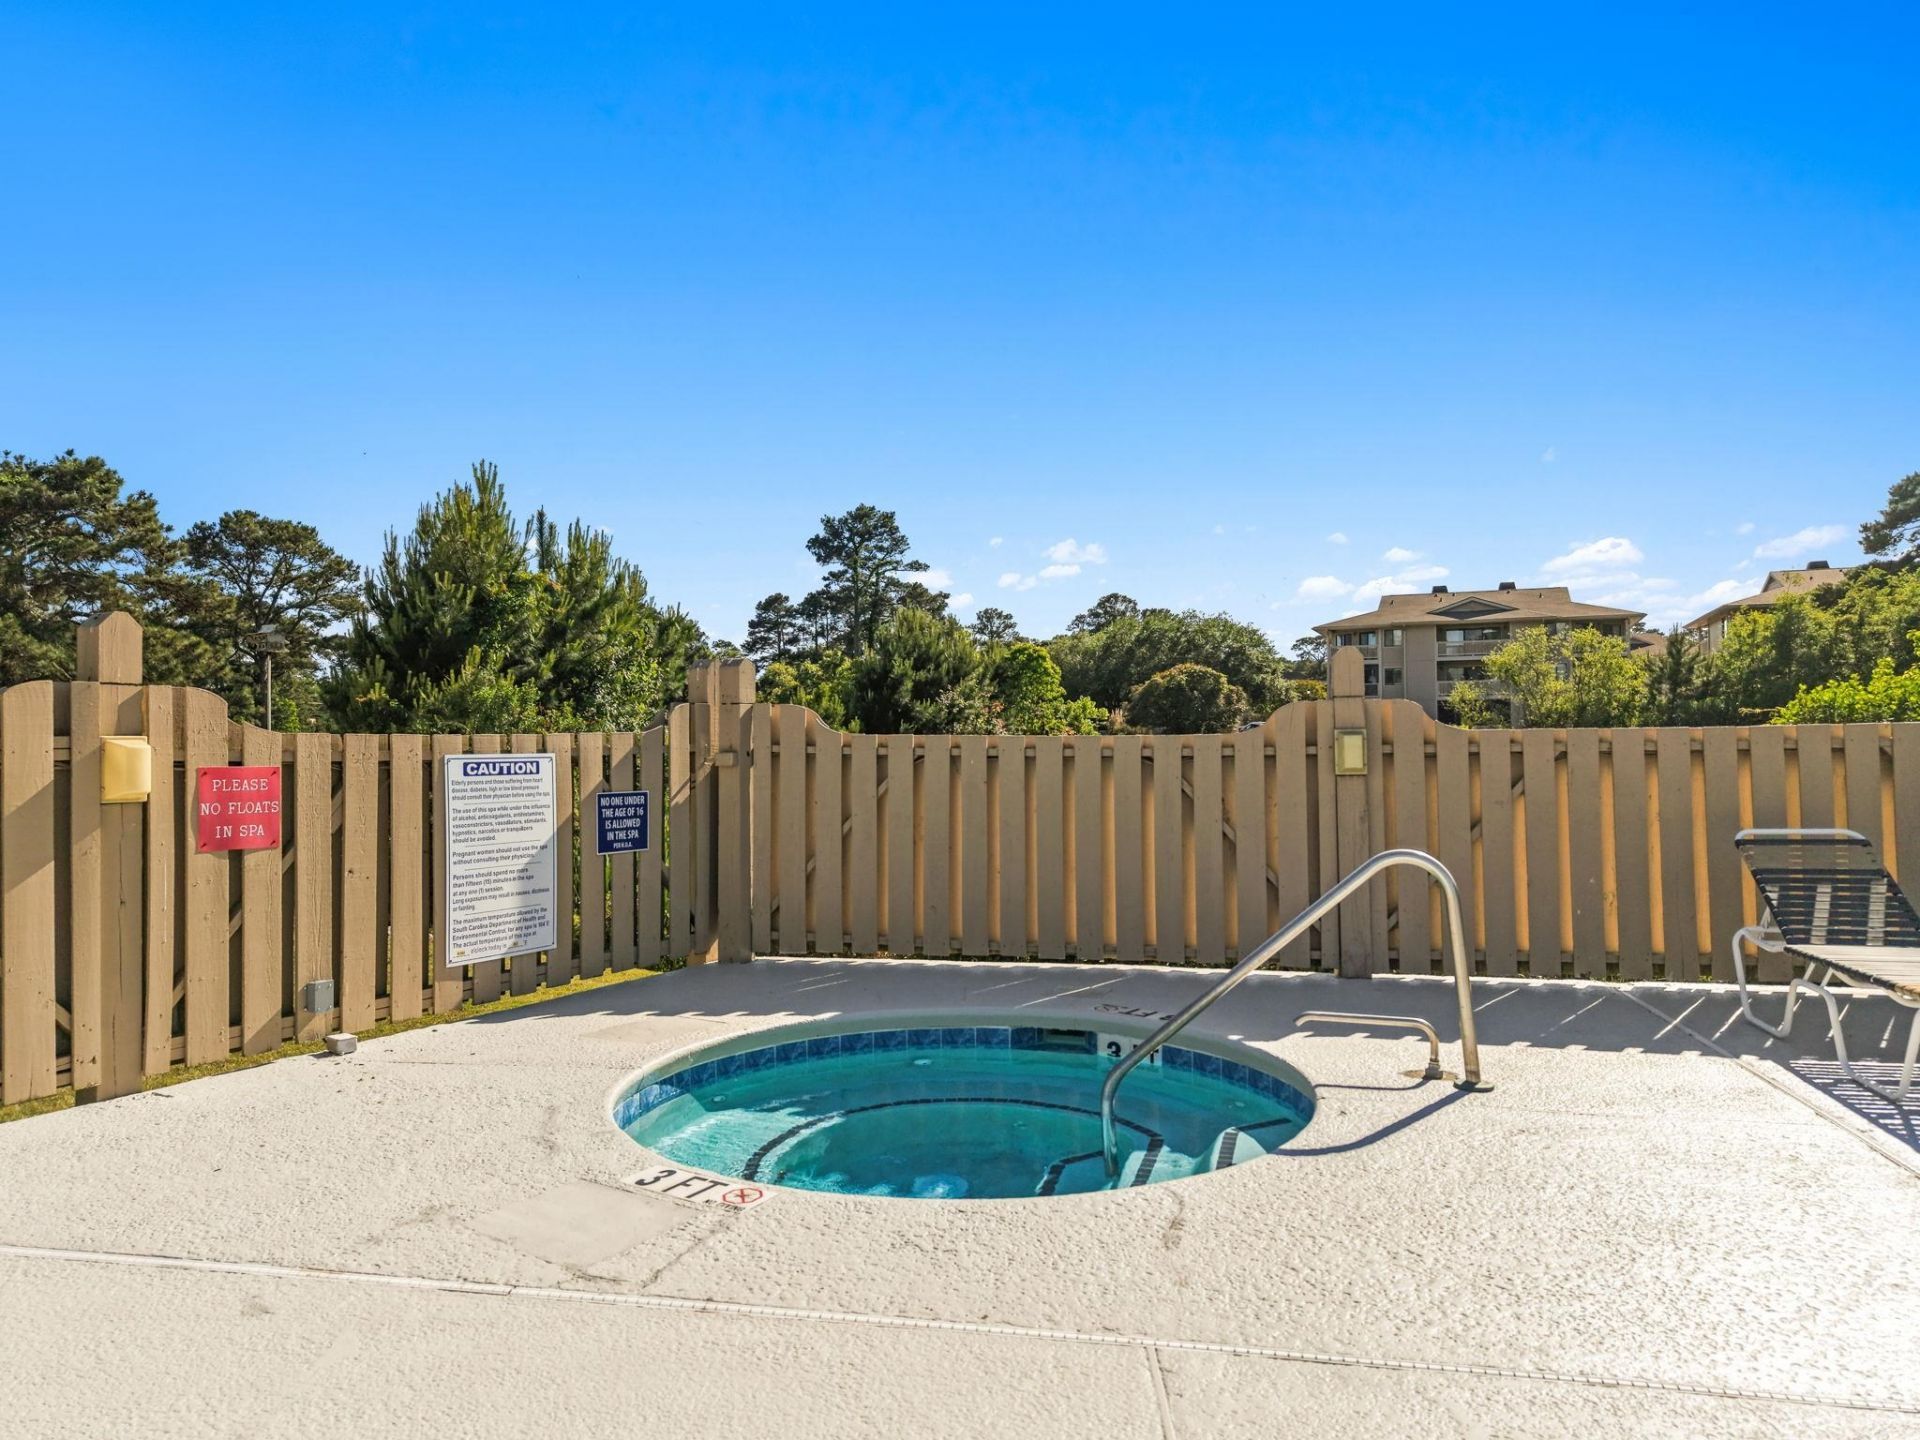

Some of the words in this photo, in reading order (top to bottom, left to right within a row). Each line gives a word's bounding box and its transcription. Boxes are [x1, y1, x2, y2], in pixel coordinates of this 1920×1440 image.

[466, 762, 537, 775] CAUTION
[212, 779, 268, 791] PLEASE
[493, 792, 511, 800] physician
[601, 797, 610, 806] NO
[611, 796, 623, 806] ONE
[624, 796, 645, 805] UNDER
[201, 803, 220, 815] NO
[228, 801, 279, 814] FLOATS
[602, 809, 613, 817] THE
[615, 808, 626, 817] AGE
[627, 807, 635, 816] OF
[636, 807, 644, 815] 16
[605, 820, 611, 829] IS
[612, 818, 640, 828] ALLOWED
[216, 826, 232, 838] IN
[240, 825, 264, 837] SPA
[607, 831, 614, 840] IN
[615, 831, 626, 839] THE
[627, 830, 639, 839] SPA
[453, 850, 476, 858] Pregnant
[488, 912, 516, 922] temperature
[469, 923, 488, 931] Carolina
[489, 920, 516, 928] Department
[453, 932, 488, 941] Environmental
[479, 936, 507, 945] temperature
[635, 1169, 677, 1186] 3
[662, 1176, 729, 1198] FT
